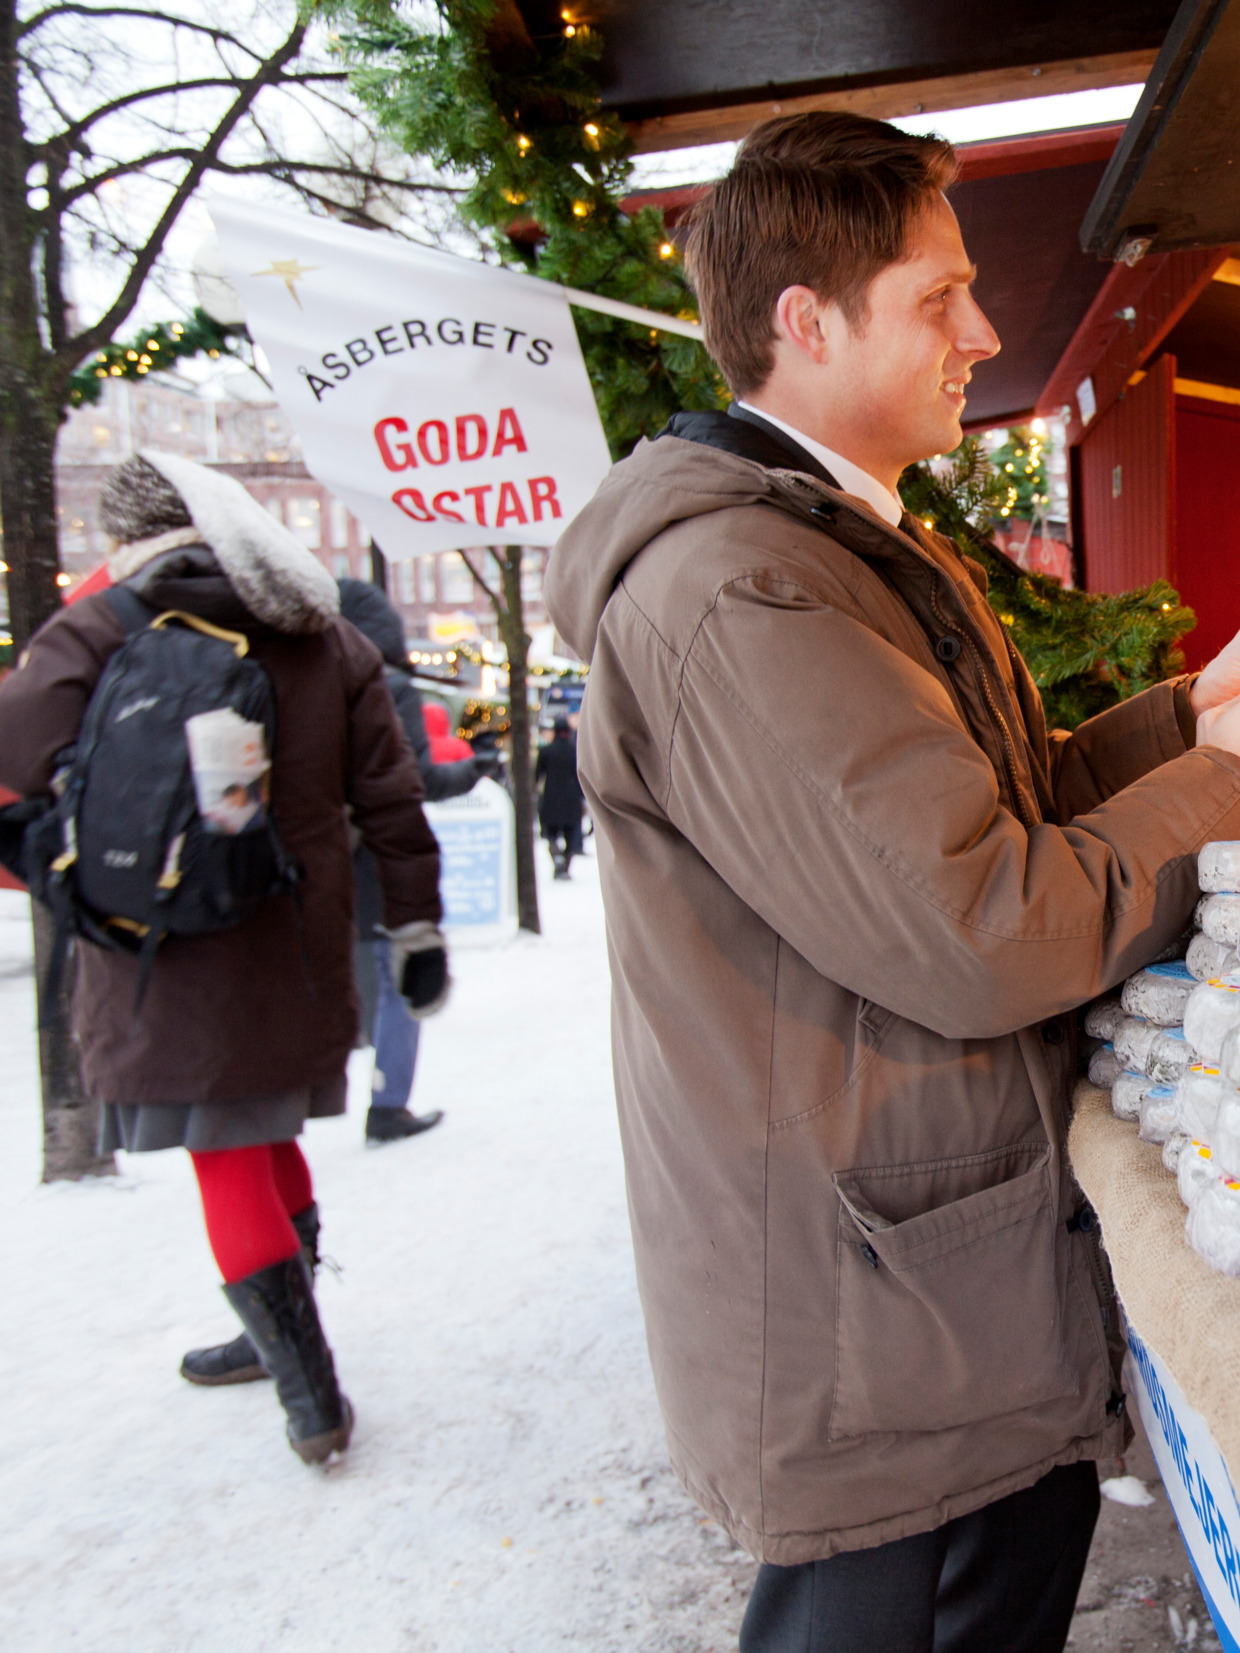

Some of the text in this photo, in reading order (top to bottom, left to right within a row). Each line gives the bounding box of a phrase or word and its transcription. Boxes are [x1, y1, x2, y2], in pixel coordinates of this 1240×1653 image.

[297, 318, 553, 402] ÅSBERGETS
[373, 407, 528, 472] GODA
[391, 476, 562, 528] OSTAR
